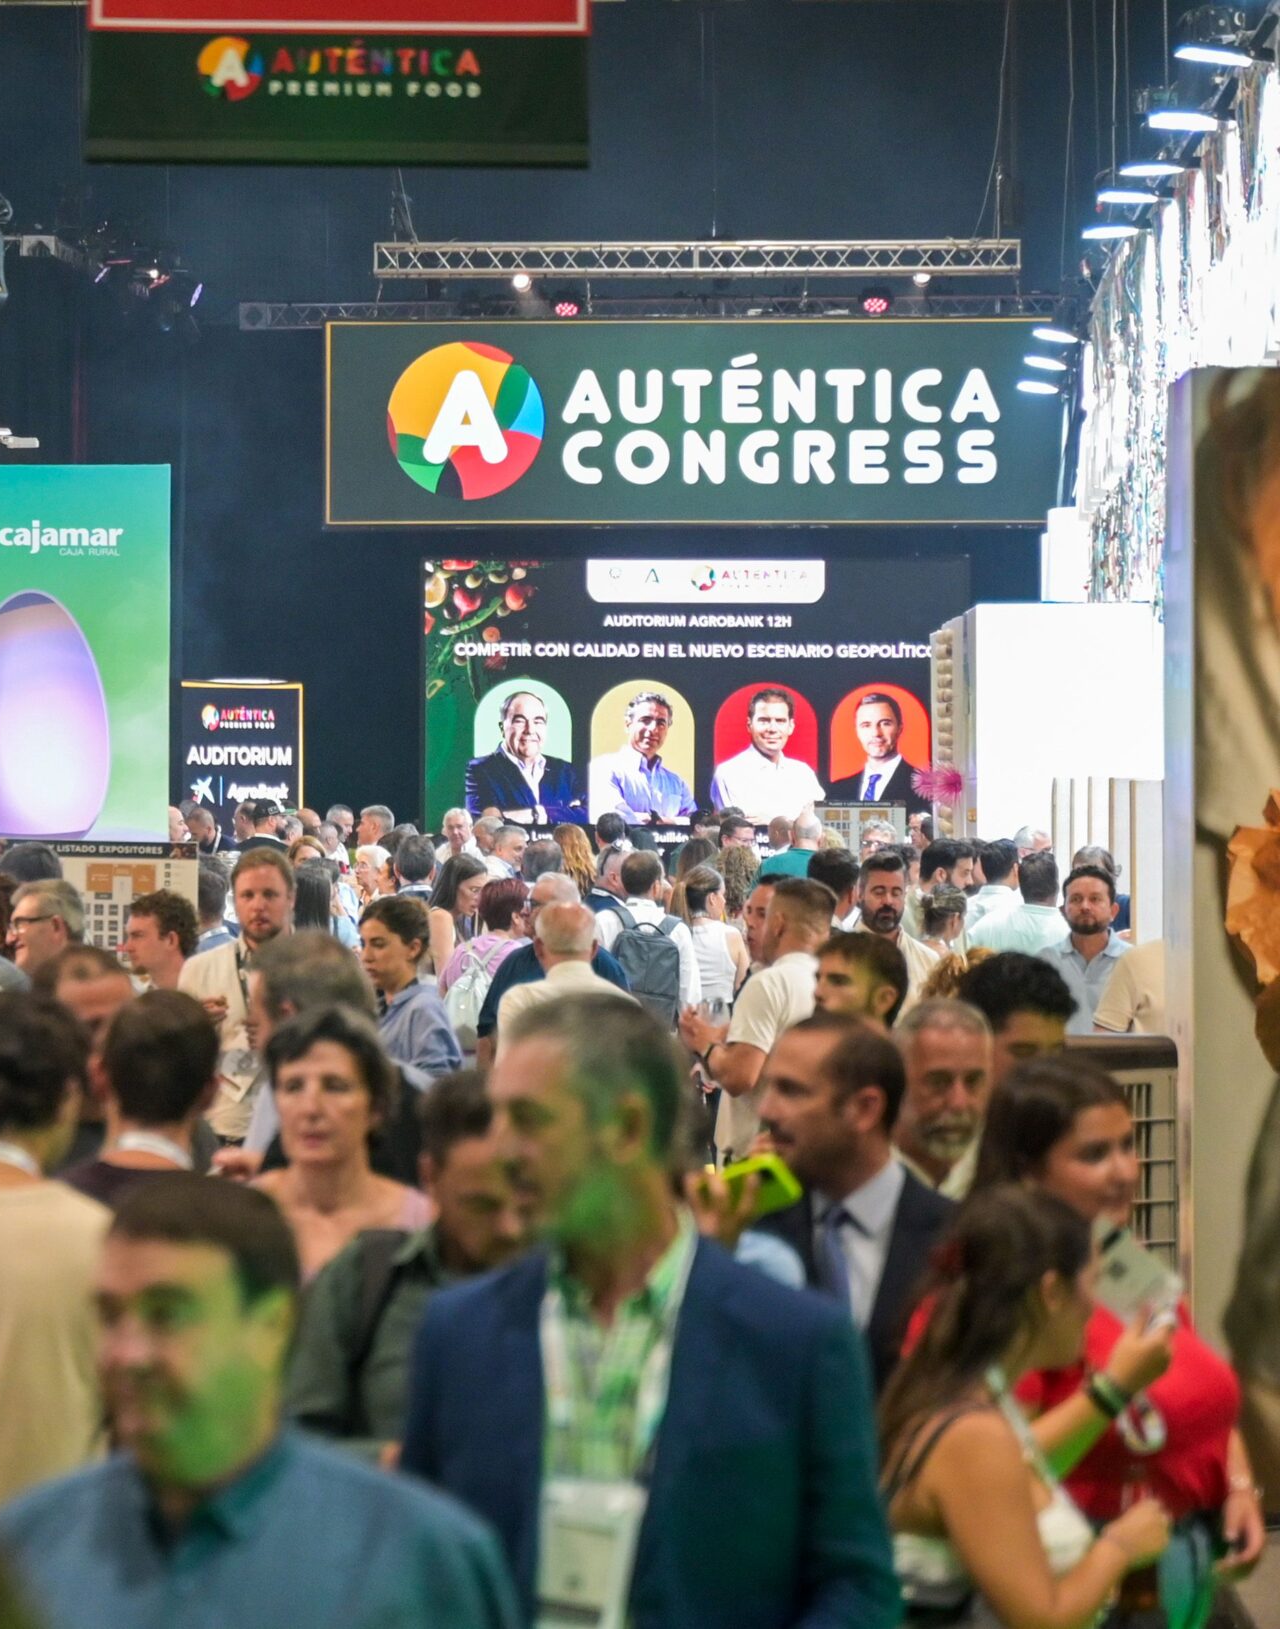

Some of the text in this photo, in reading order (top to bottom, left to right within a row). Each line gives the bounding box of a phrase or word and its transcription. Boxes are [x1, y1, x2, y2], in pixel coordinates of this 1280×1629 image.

[271, 39, 481, 77] AUTÉNTICA
[269, 81, 482, 98] PREMIUM FOOD
[562, 352, 1001, 424] AUTÉNTICA
[562, 430, 999, 485] CONGRESS
[59, 548, 120, 556] CAJA RURAL
[603, 614, 792, 628] AUDITORIUM AGROBANK 12H
[453, 642, 532, 657] COMPETIR
[535, 642, 570, 657] CON
[573, 643, 640, 658] CALIDAD
[643, 643, 665, 658] EN
[668, 643, 686, 658] EL
[689, 644, 744, 658] NUEVO
[747, 644, 833, 658] ESCENARIO
[186, 745, 293, 766] AUDITORIUM
[56, 845, 95, 853] LISTADO
[98, 845, 163, 855] EXPOSITORES
